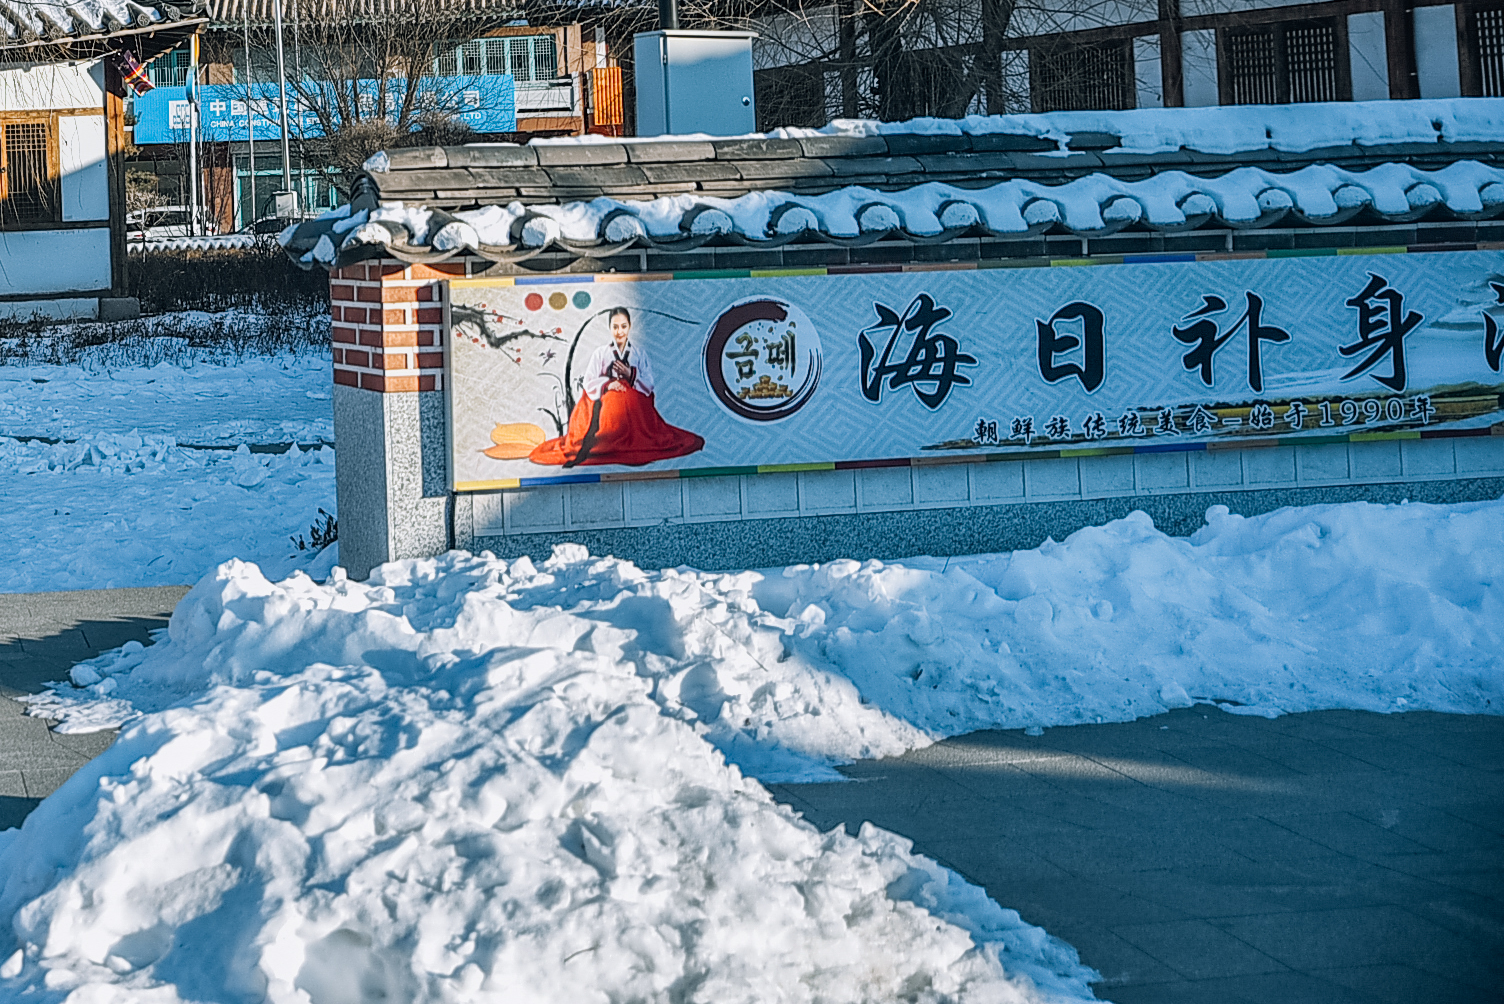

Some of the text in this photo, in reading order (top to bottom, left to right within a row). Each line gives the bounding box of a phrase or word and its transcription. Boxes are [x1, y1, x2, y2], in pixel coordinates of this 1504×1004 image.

[210, 119, 235, 128] CHINA
[857, 271, 1504, 411] 海日补身
